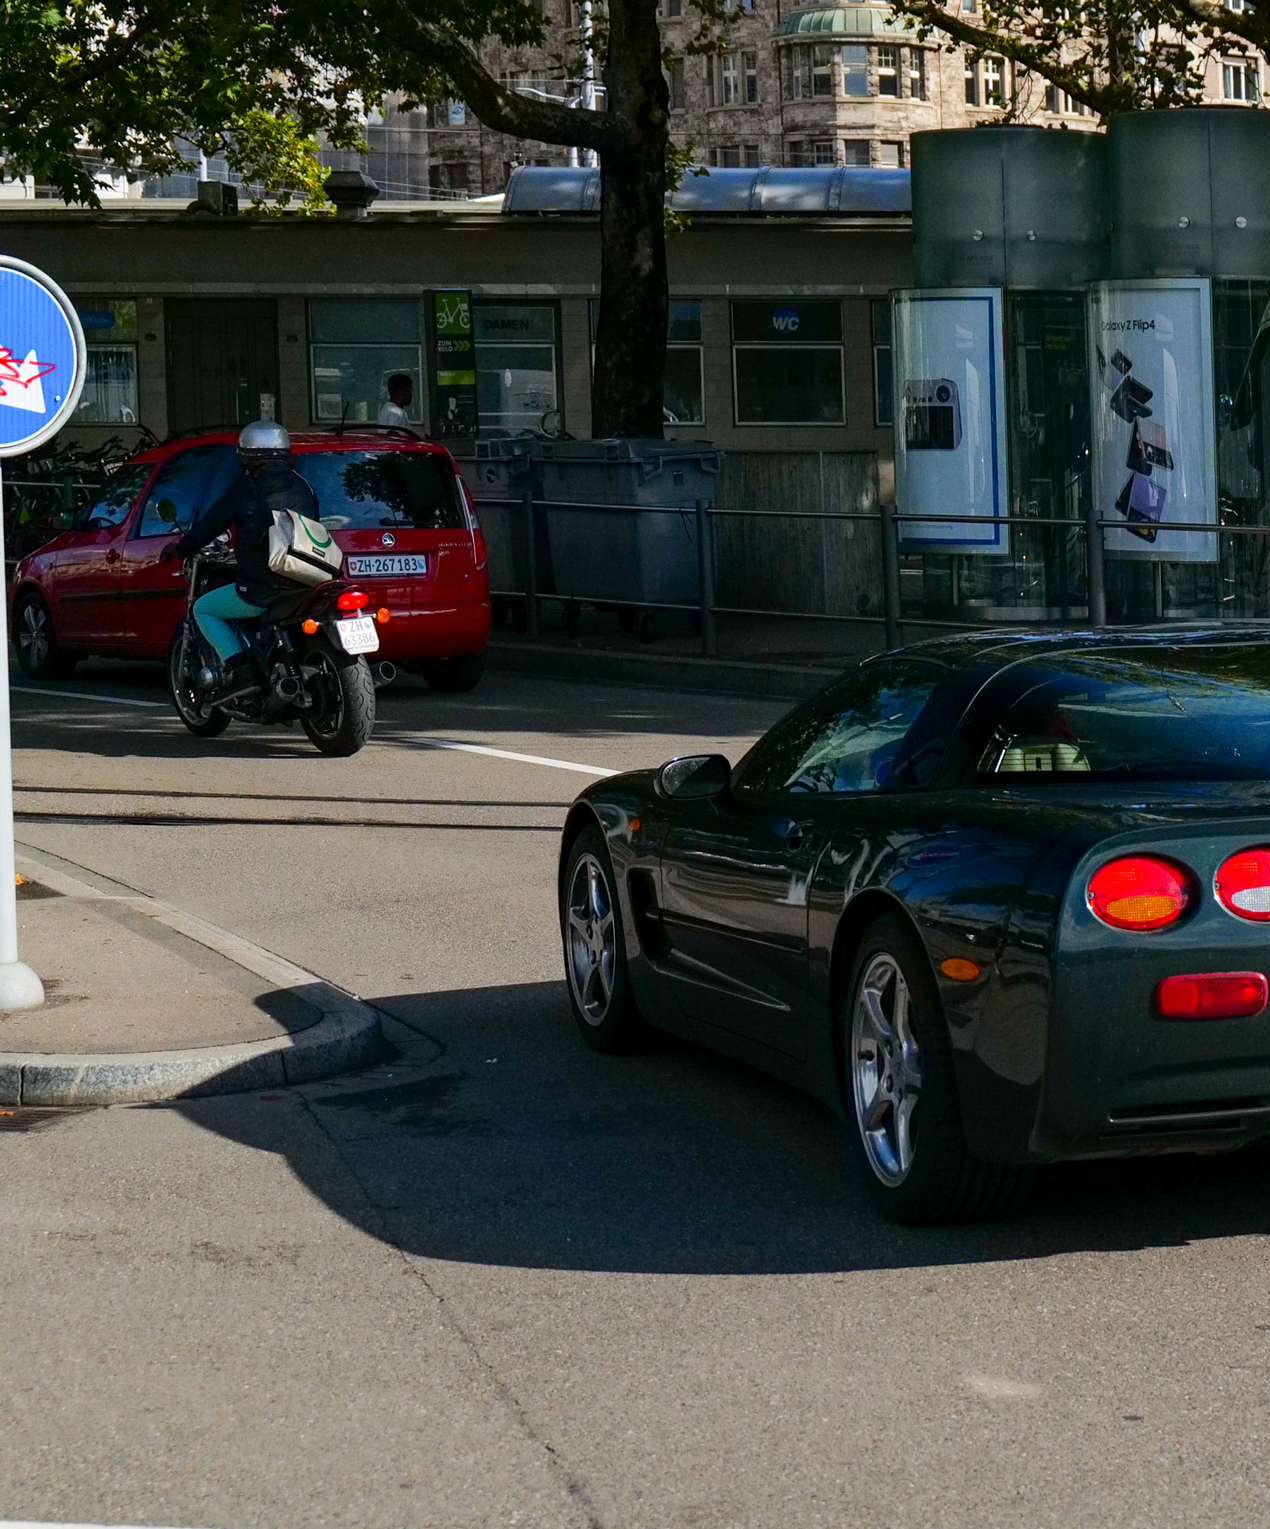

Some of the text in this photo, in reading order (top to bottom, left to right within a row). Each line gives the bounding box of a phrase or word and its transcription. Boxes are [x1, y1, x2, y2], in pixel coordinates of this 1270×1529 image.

[484, 319, 529, 331] DAMEN
[772, 316, 800, 331] WC
[1101, 319, 1156, 333] Galaxy Z Flip4
[348, 620, 364, 632] ZH
[344, 632, 376, 647] 63386
